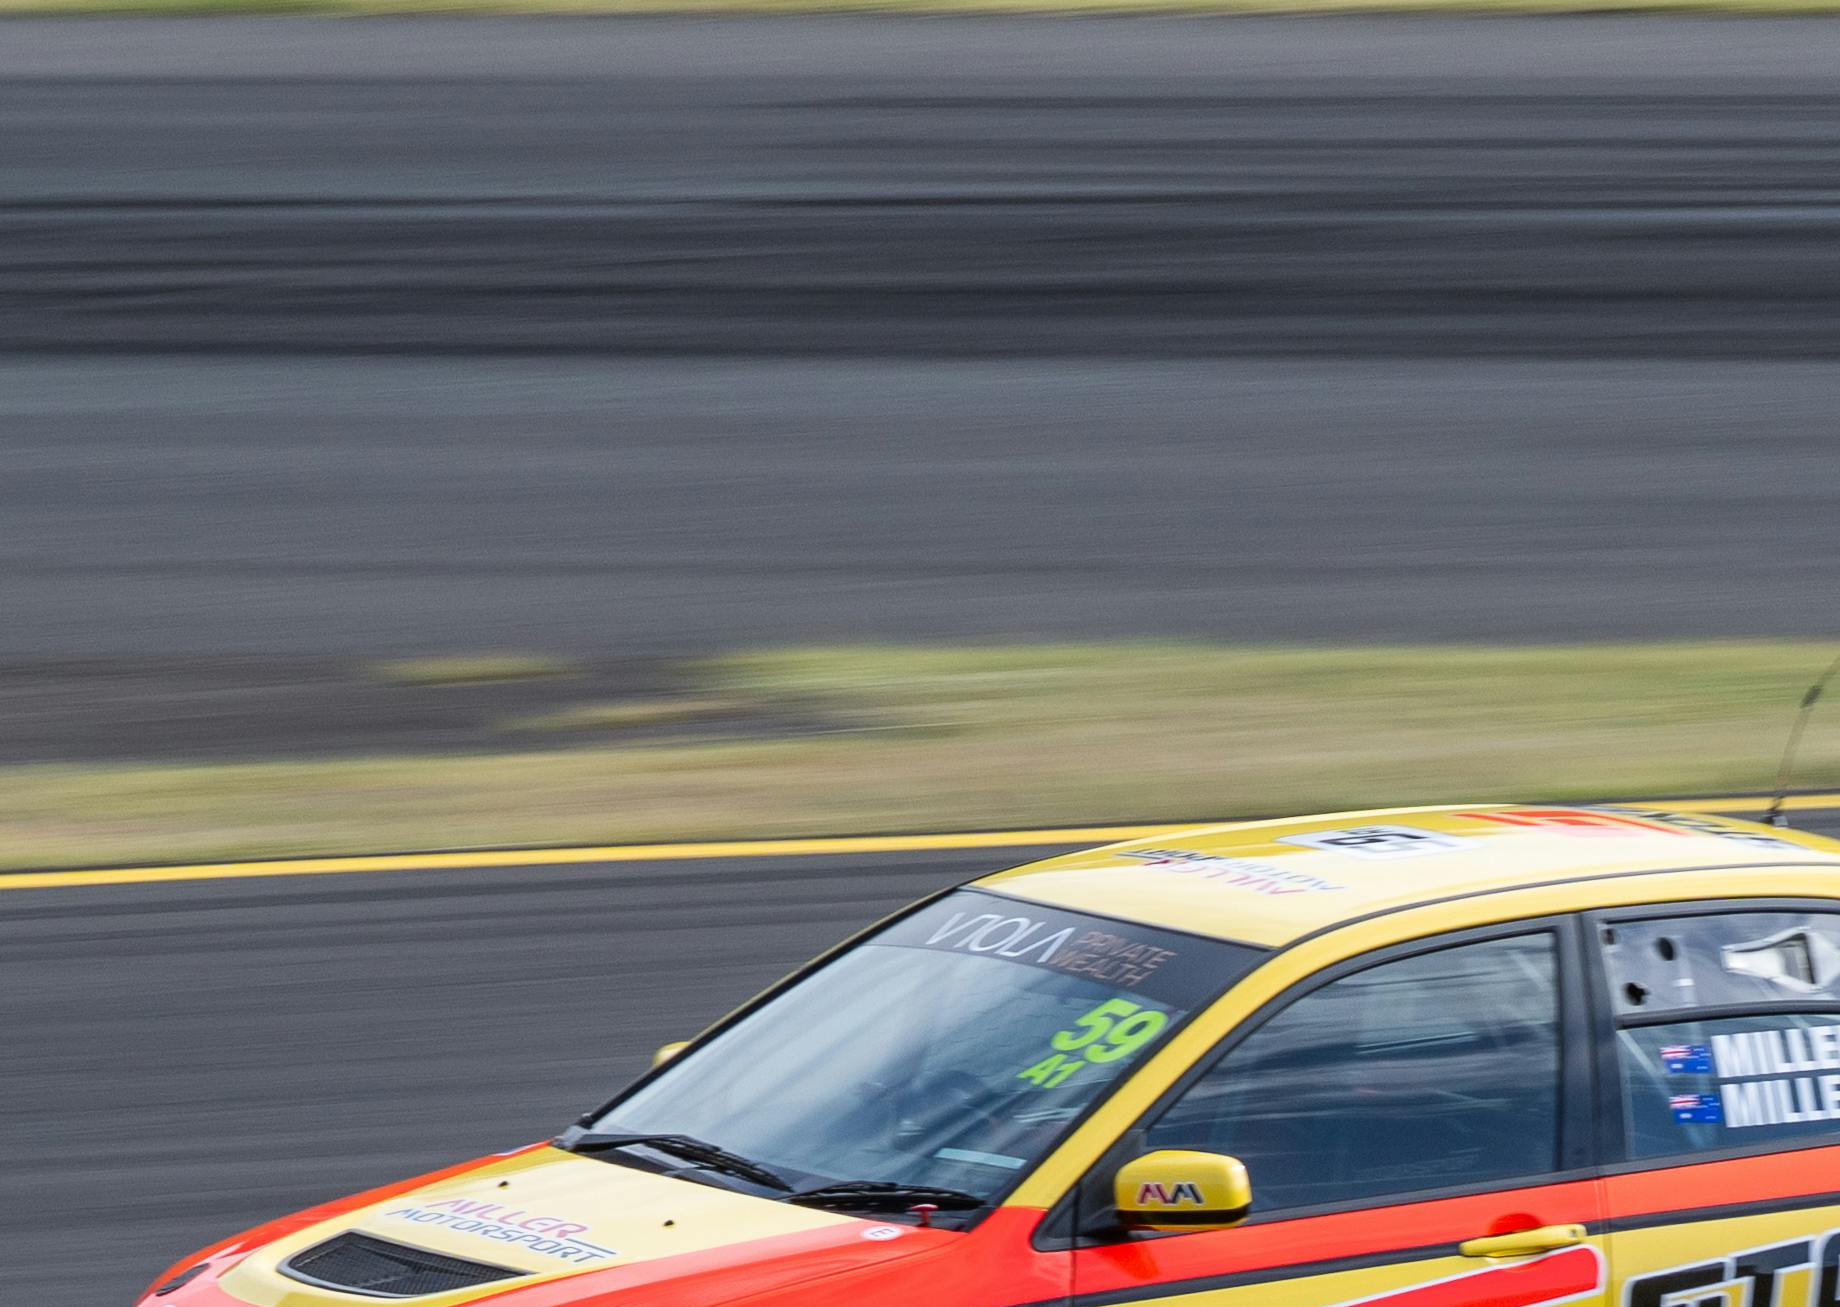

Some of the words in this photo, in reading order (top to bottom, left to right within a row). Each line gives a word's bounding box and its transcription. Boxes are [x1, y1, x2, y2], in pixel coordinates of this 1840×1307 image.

[1049, 950, 1153, 986] WEALTH
[1071, 931, 1178, 968] PRIVATE
[1051, 998, 1168, 1063] 59
[1016, 1053, 1086, 1089] A1
[386, 1208, 605, 1263] MOTORSPORT
[425, 1199, 588, 1238] MILLER
